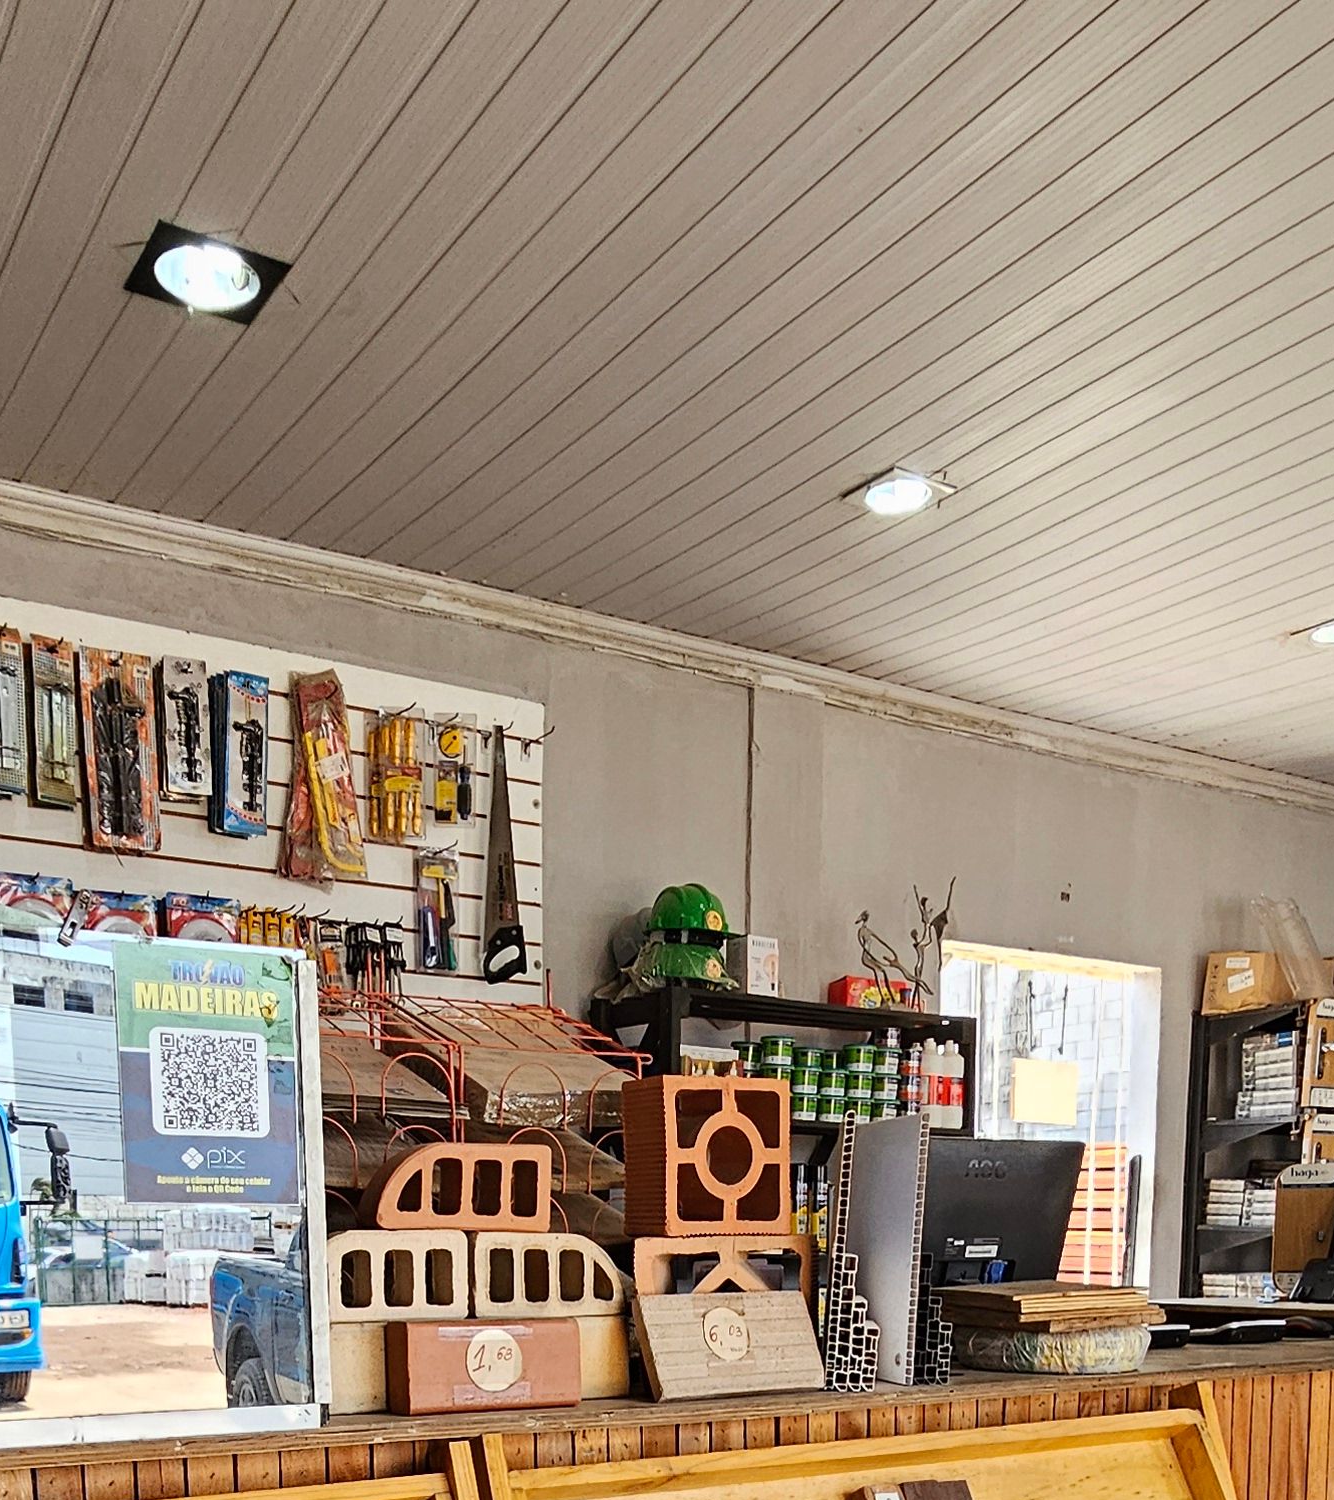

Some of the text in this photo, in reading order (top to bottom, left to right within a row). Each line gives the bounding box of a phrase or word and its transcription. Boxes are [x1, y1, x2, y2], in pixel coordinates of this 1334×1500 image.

[170, 959, 245, 986] TROVÃO
[134, 981, 280, 1019] MADEIRAS
[207, 1147, 245, 1169] pix
